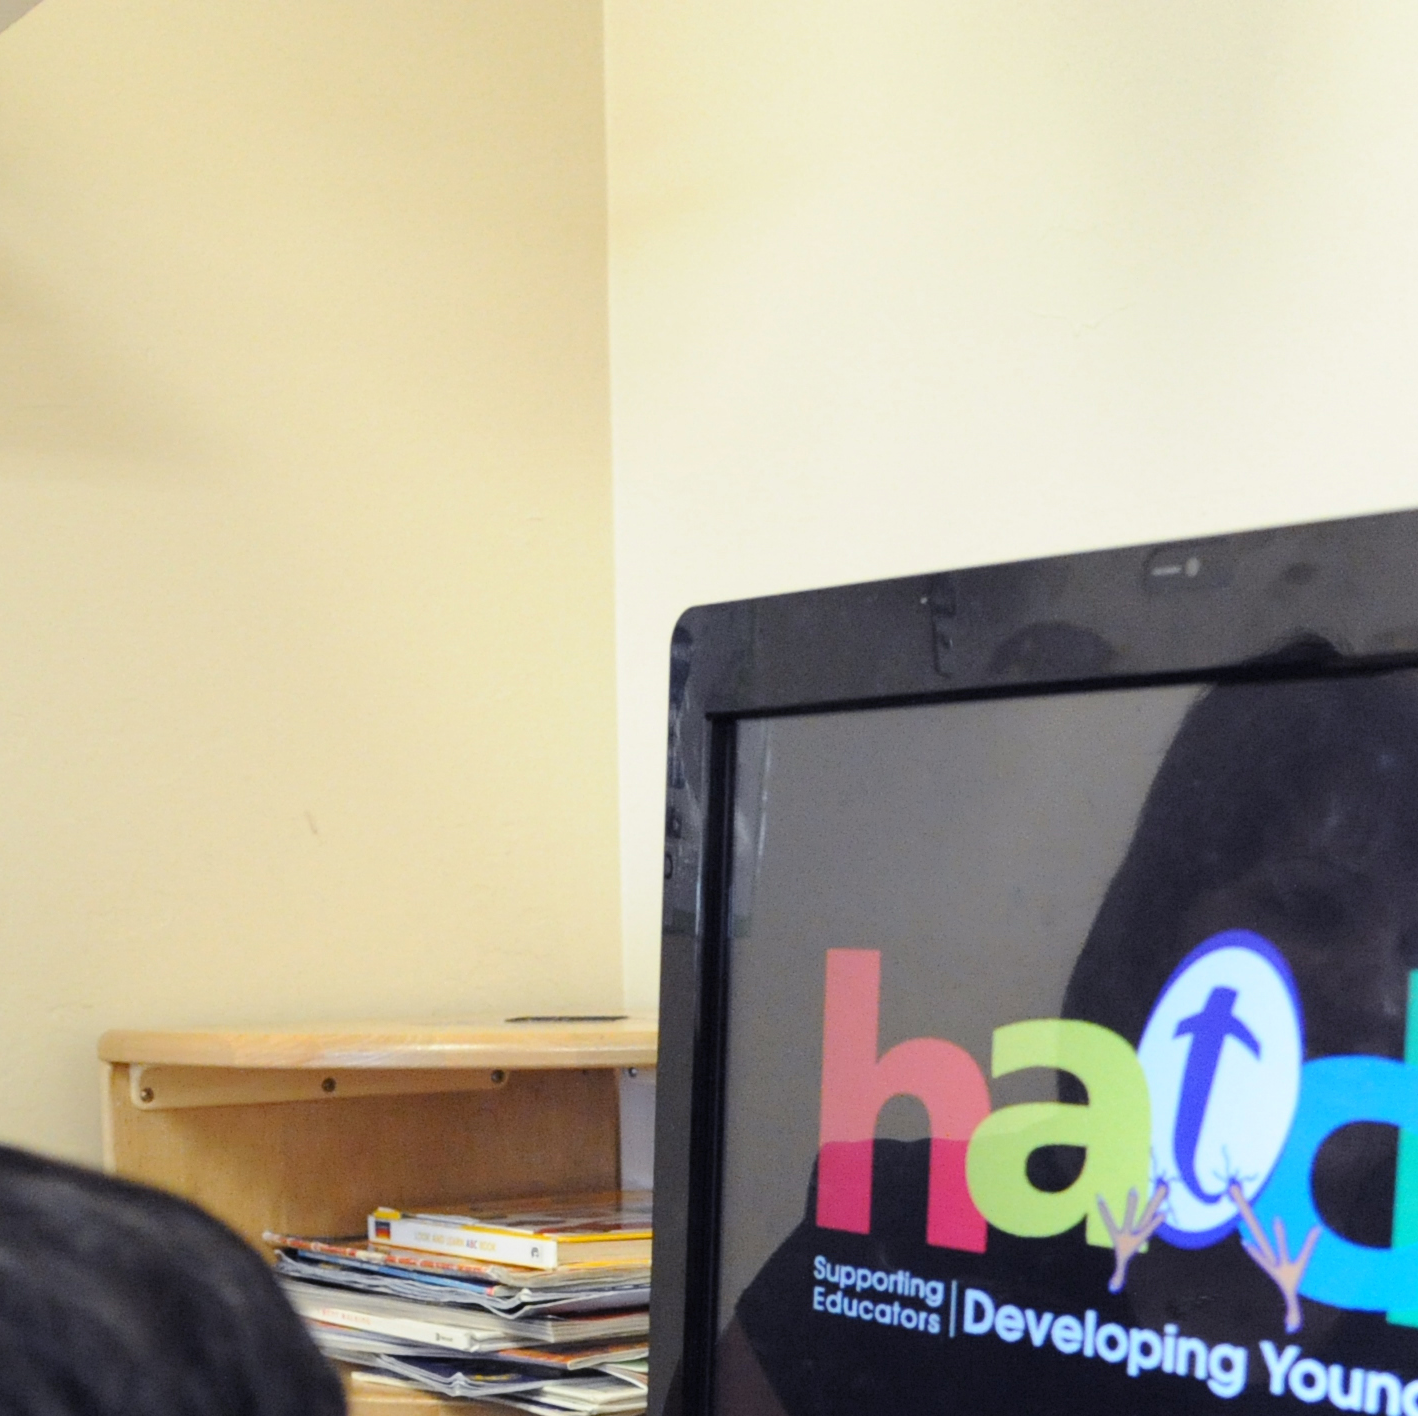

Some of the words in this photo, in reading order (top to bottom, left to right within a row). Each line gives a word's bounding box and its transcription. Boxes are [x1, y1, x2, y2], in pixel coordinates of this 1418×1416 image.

[813, 1255, 944, 1307] Supporting
[813, 1286, 941, 1334] Educators
[963, 1288, 1248, 1399] Developing
